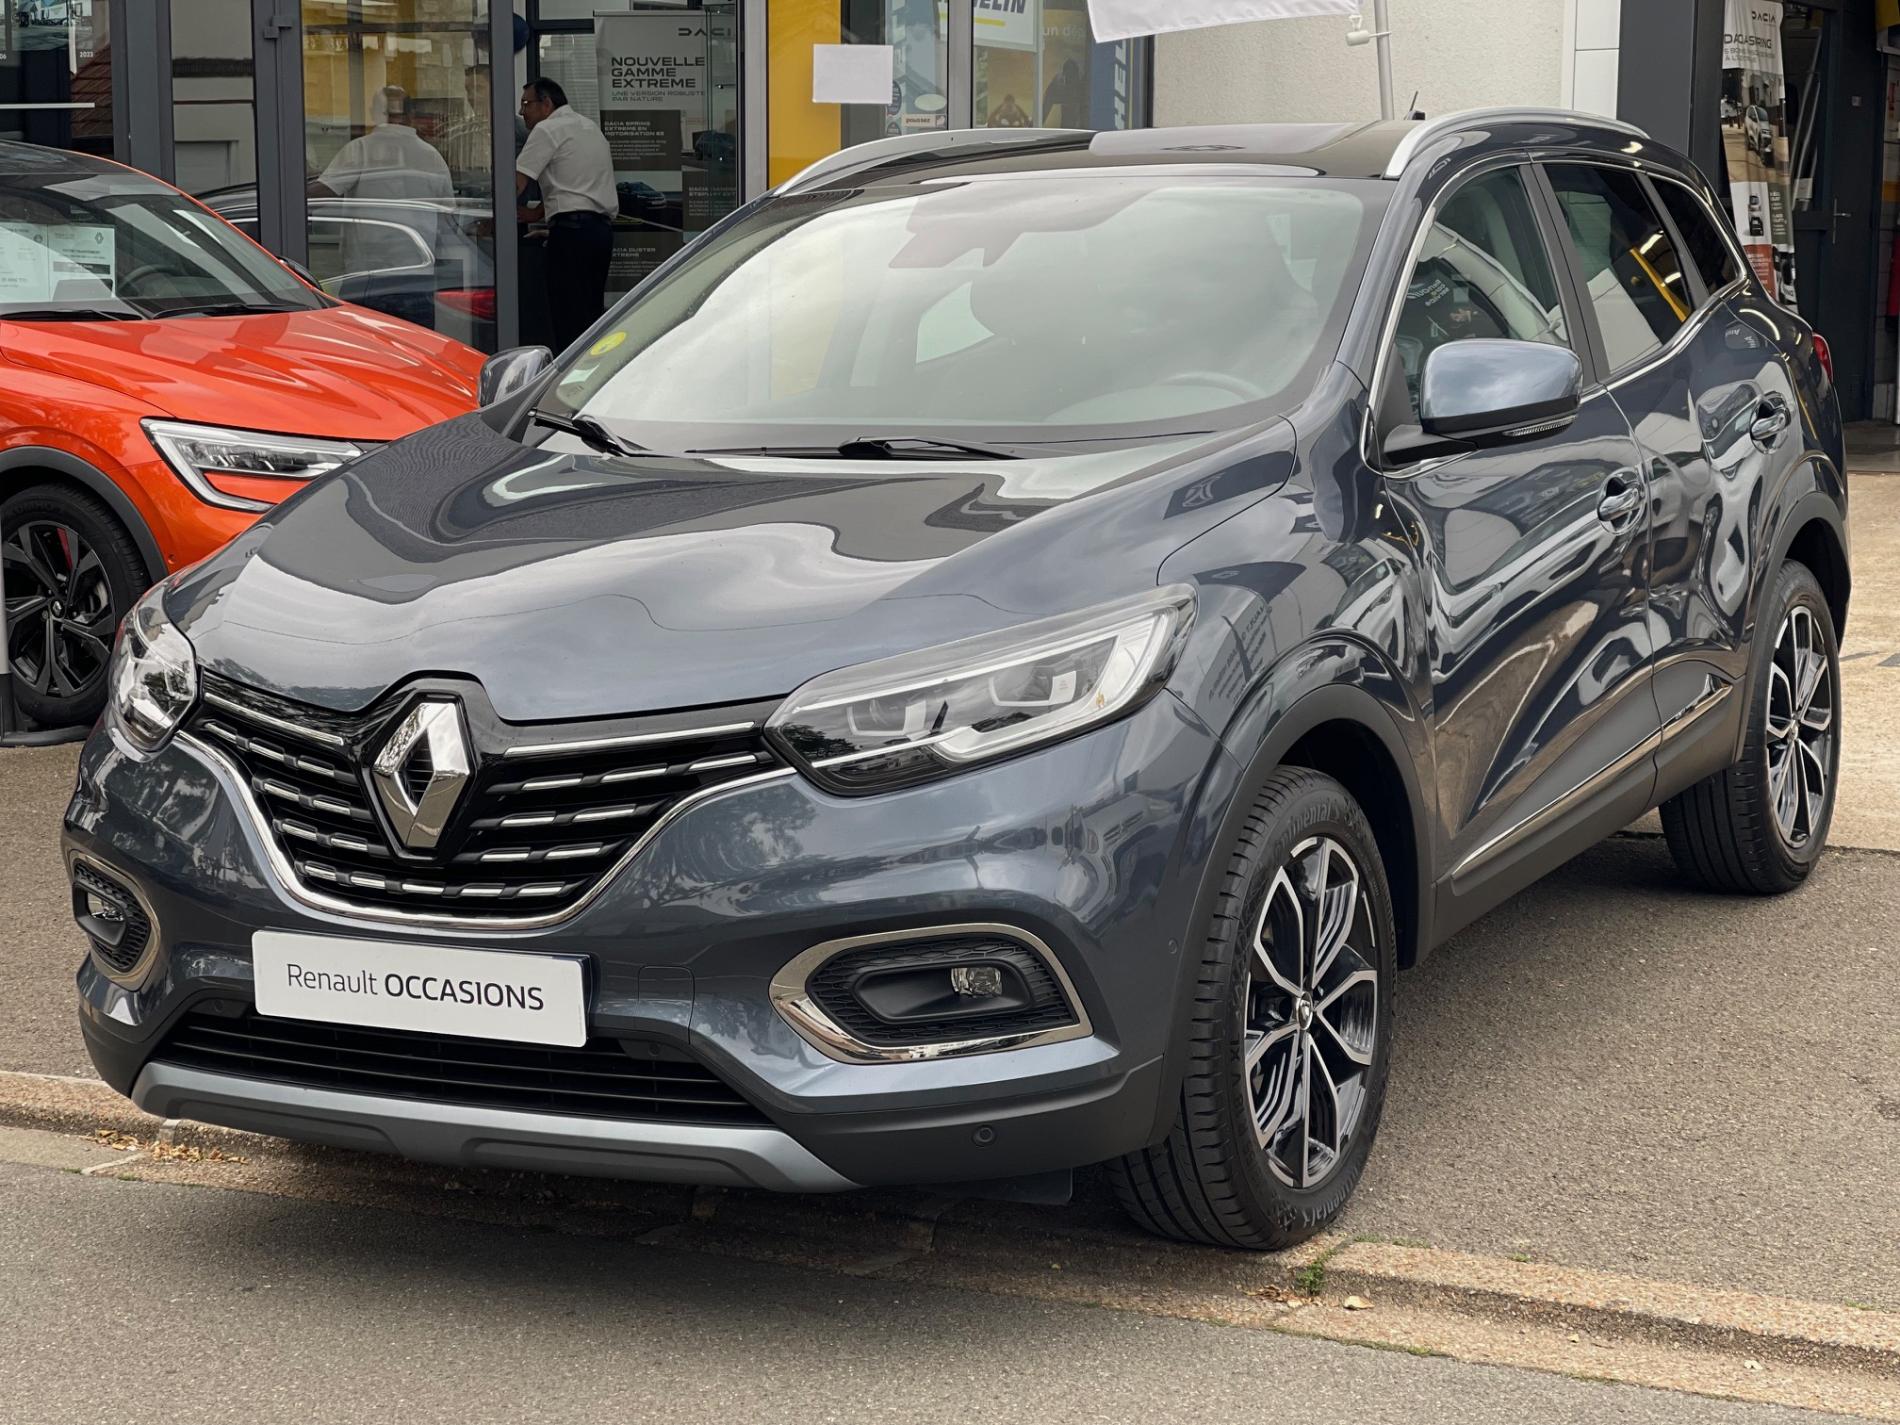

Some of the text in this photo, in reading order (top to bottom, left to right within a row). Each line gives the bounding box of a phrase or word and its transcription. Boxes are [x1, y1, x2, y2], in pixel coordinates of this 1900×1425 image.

[678, 28, 732, 36] DACI
[611, 57, 706, 67] NOUVELLE
[611, 68, 676, 78] GAMME
[611, 79, 696, 88] EXTREME
[286, 963, 544, 1011] Renault OCCASIONS
